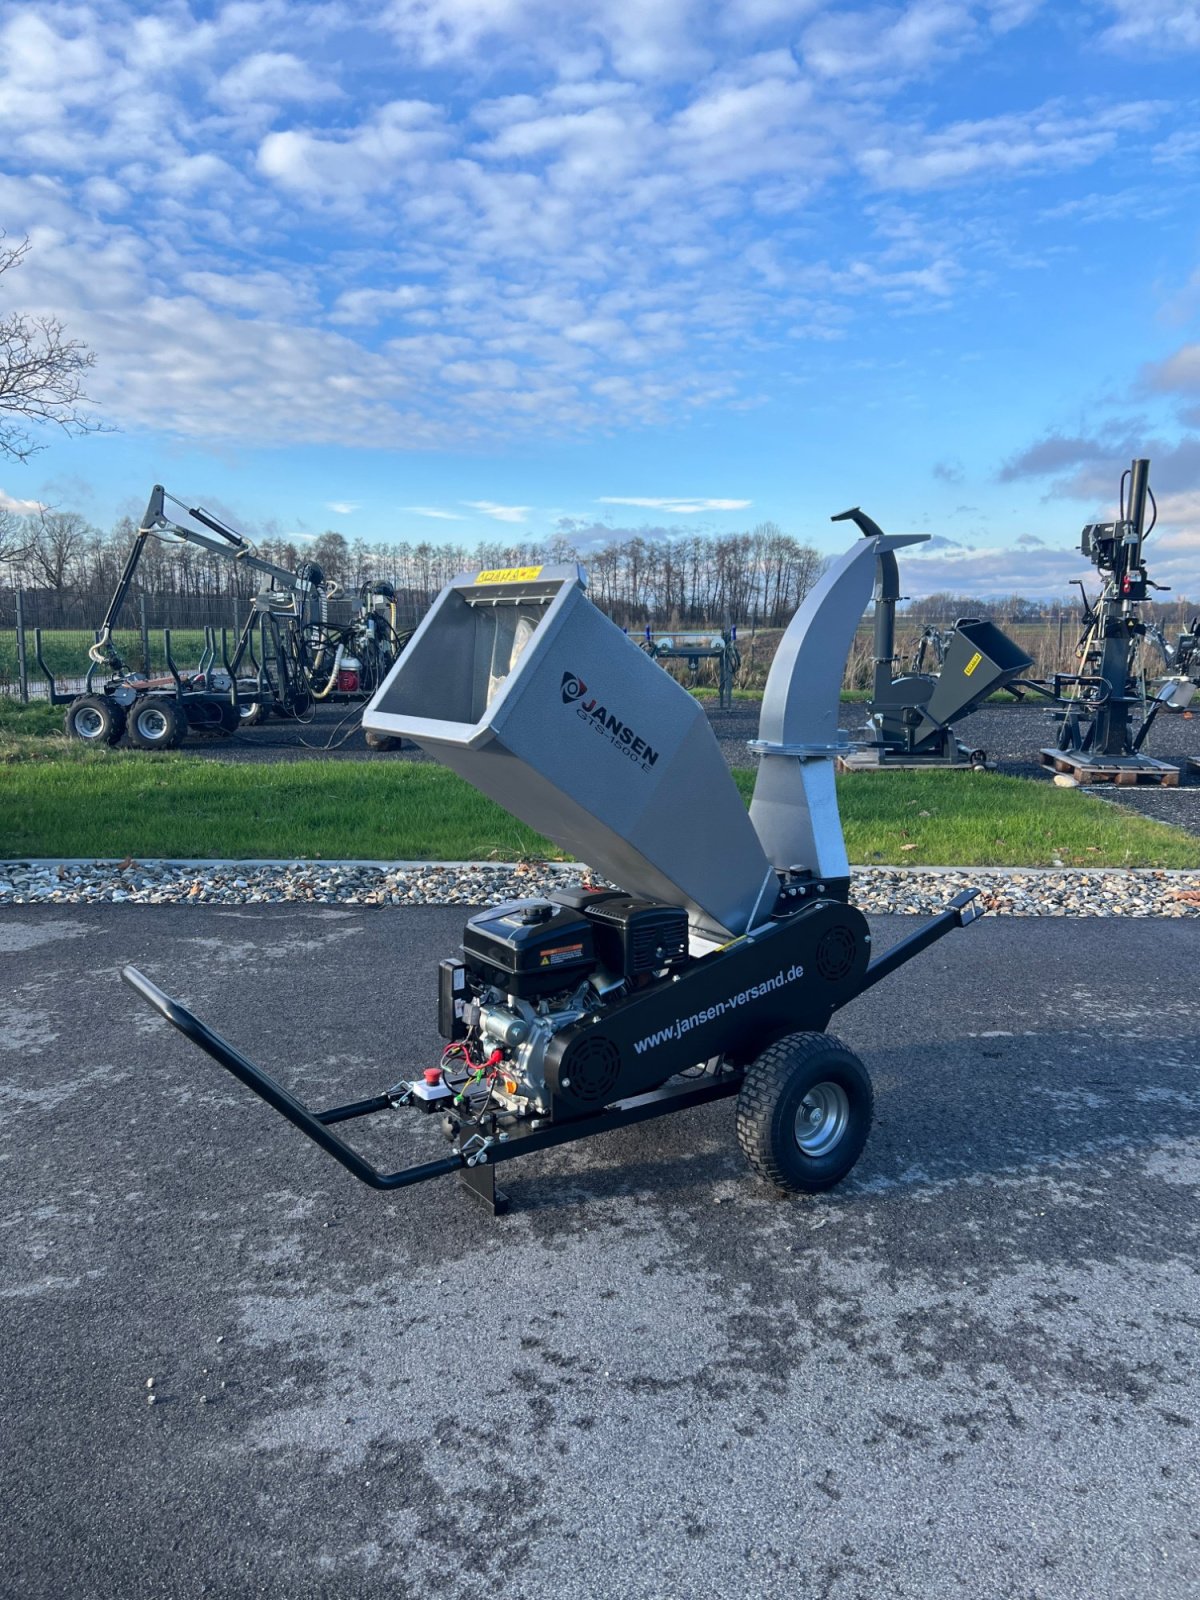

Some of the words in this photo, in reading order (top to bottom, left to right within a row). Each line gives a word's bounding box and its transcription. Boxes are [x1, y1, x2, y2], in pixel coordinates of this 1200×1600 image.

[576, 708, 652, 774] GTS-1500-E
[581, 699, 659, 766] JANSEN
[633, 964, 804, 1054] www.jansen-versand.de
